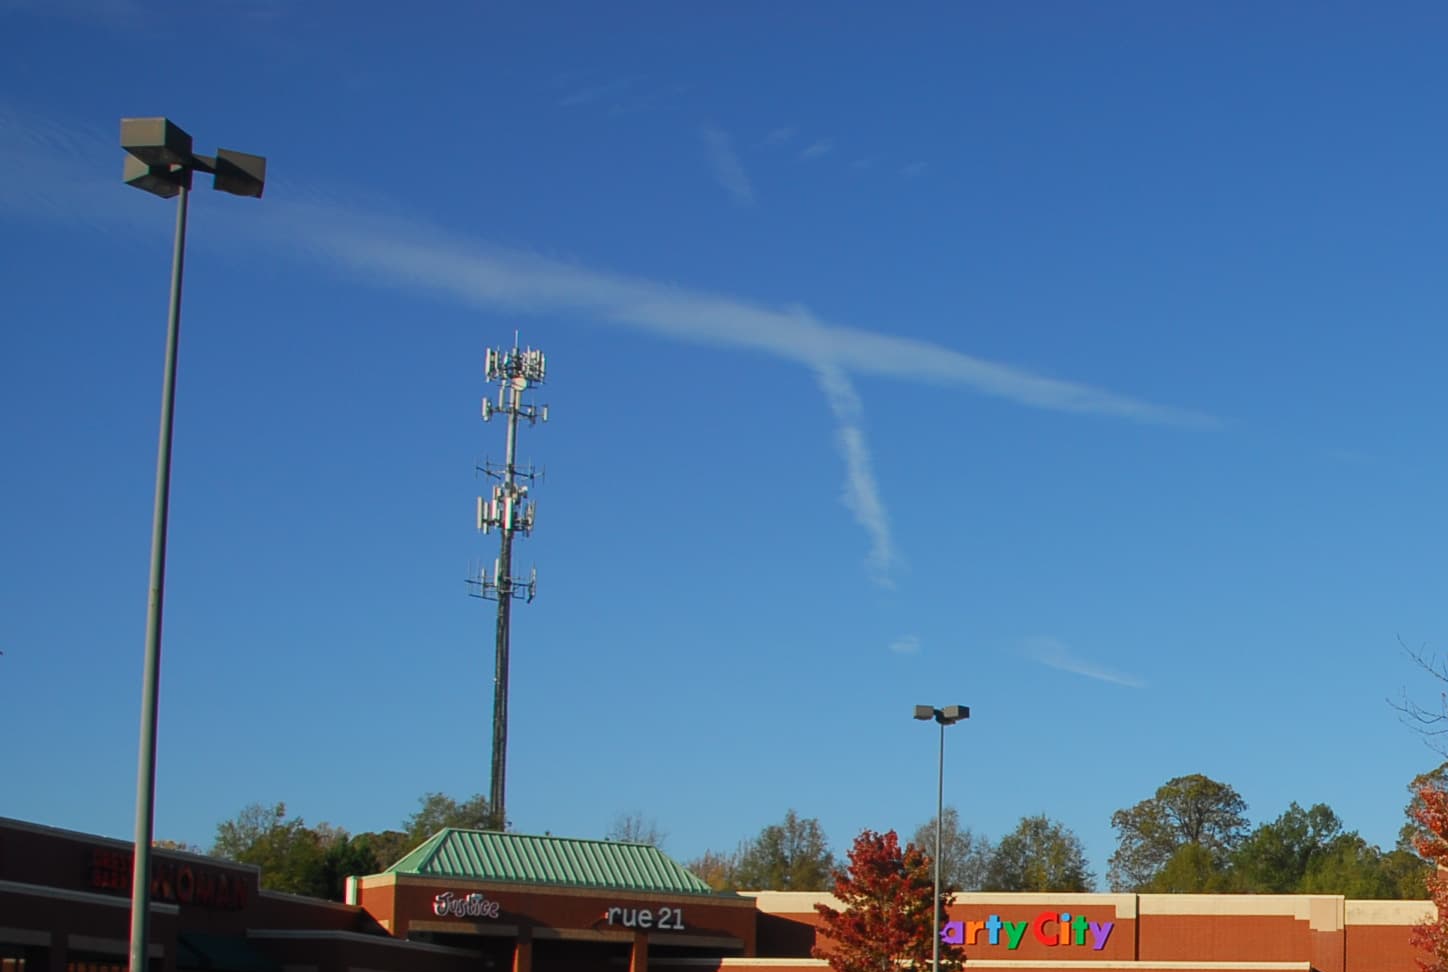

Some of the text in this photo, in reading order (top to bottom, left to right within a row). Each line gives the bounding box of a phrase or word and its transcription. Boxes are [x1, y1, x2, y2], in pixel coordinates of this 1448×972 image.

[433, 891, 500, 919] Justice
[940, 911, 1115, 951] arty City
